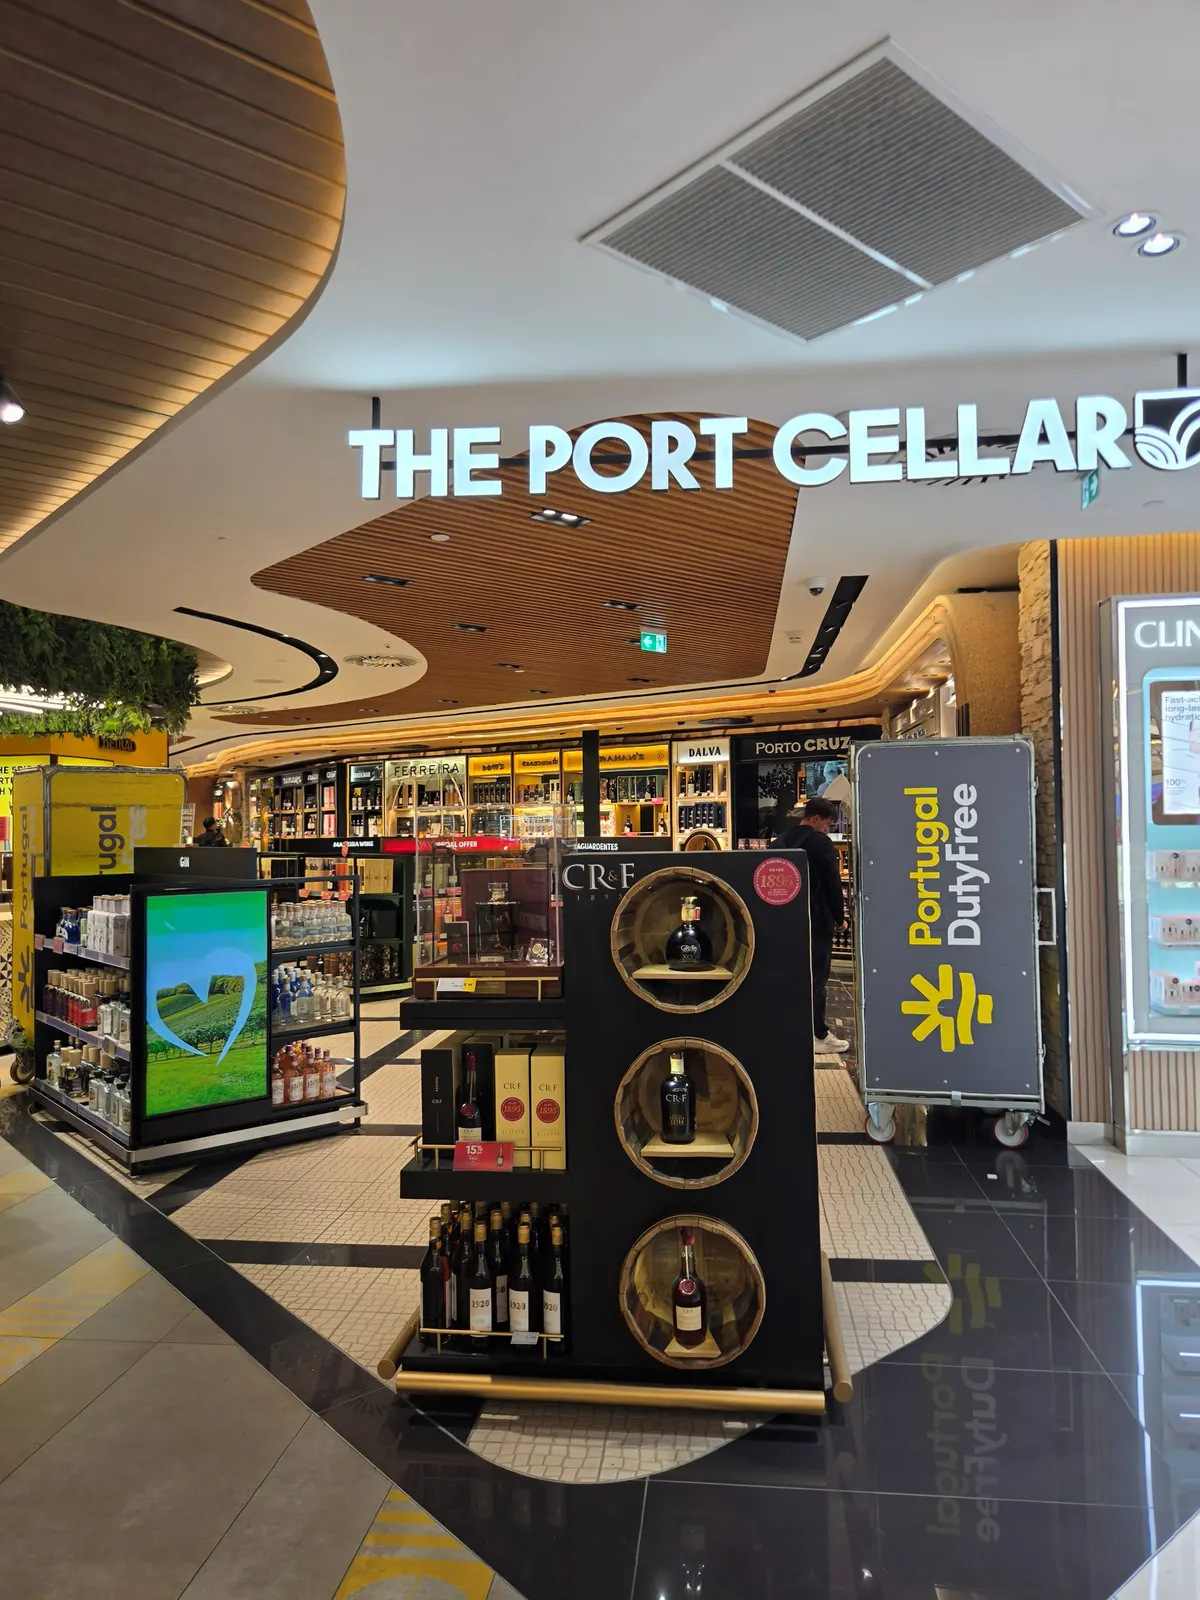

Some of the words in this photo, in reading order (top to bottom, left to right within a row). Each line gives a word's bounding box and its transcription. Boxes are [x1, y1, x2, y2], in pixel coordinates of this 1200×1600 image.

[348, 427, 502, 499] THE
[528, 417, 748, 494] PORT
[772, 395, 1133, 485] CELLAR
[1134, 620, 1200, 648] CLIN
[755, 741, 801, 754] PORTO
[804, 736, 851, 751] CRUZ
[689, 746, 721, 757] DALVA
[394, 763, 460, 776] FERREIRA
[90, 806, 125, 873] ugal
[458, 840, 478, 848] OFFER
[577, 843, 618, 851] AGUARDENTES
[20, 806, 30, 929] Portugal
[180, 856, 190, 868] GIN
[904, 787, 949, 946] Portugal
[945, 783, 990, 946] DutyFree
[562, 862, 635, 890] CR&F
[504, 1105, 521, 1113] 1895
[540, 1107, 557, 1115] 1895
[466, 1145, 483, 1155] 15%
[472, 1299, 489, 1308] 1920
[510, 1300, 526, 1310] 1920
